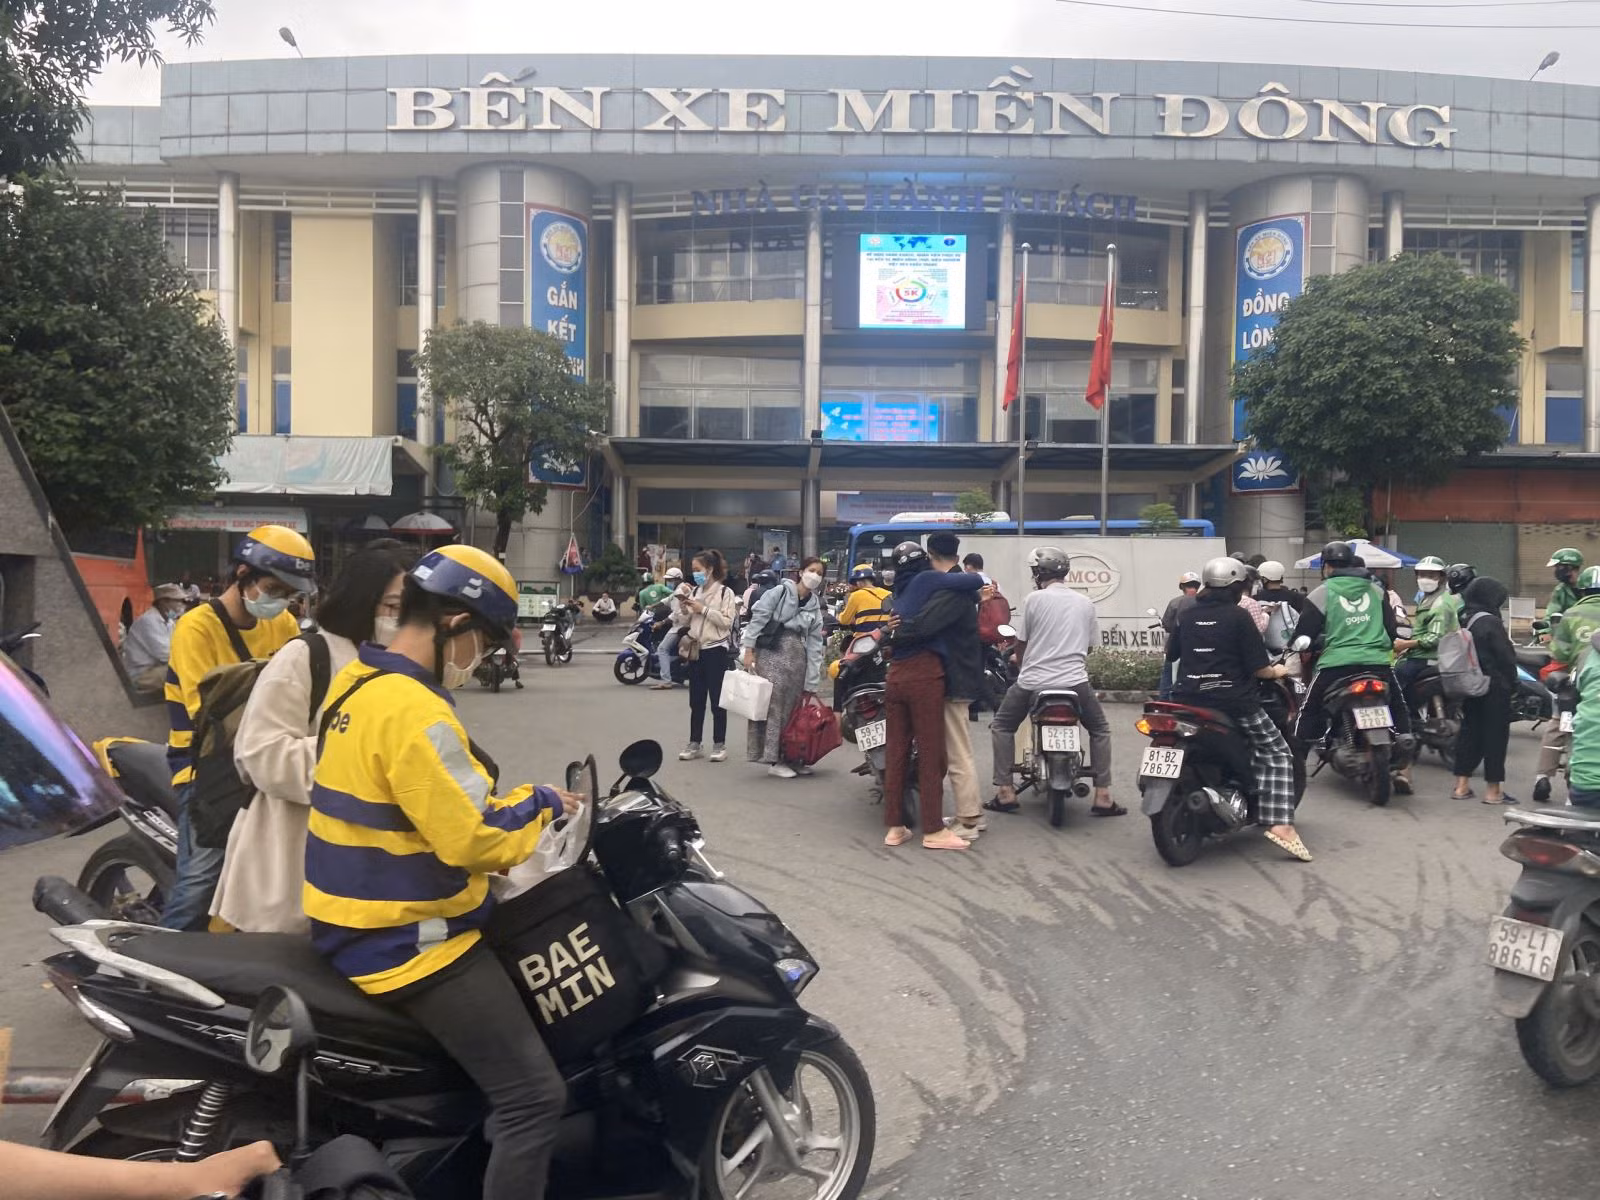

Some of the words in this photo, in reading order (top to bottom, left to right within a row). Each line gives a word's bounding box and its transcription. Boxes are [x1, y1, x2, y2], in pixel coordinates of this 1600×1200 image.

[386, 67, 612, 131] BẾN
[642, 87, 787, 132] XE
[827, 64, 1121, 136] MIỀN
[1152, 81, 1458, 149] ĐÔNG
[547, 281, 578, 310] GẮN
[1243, 288, 1291, 318] ĐỒNG
[547, 314, 577, 342] KẾT
[1242, 324, 1278, 350] LÒN
[1064, 570, 1111, 584] MCO
[1345, 613, 1372, 626] gojek
[1101, 623, 1128, 647] BẾN
[1131, 630, 1149, 647] XE
[860, 722, 884, 738] 59-F1
[860, 733, 884, 750] 195.7
[1143, 762, 1179, 776] 786.77
[1149, 750, 1177, 763] 81-B2
[1498, 924, 1549, 952] 59-L1
[518, 922, 601, 991] BAE
[1488, 942, 1552, 977] 886.16
[535, 955, 616, 1025] MIN
